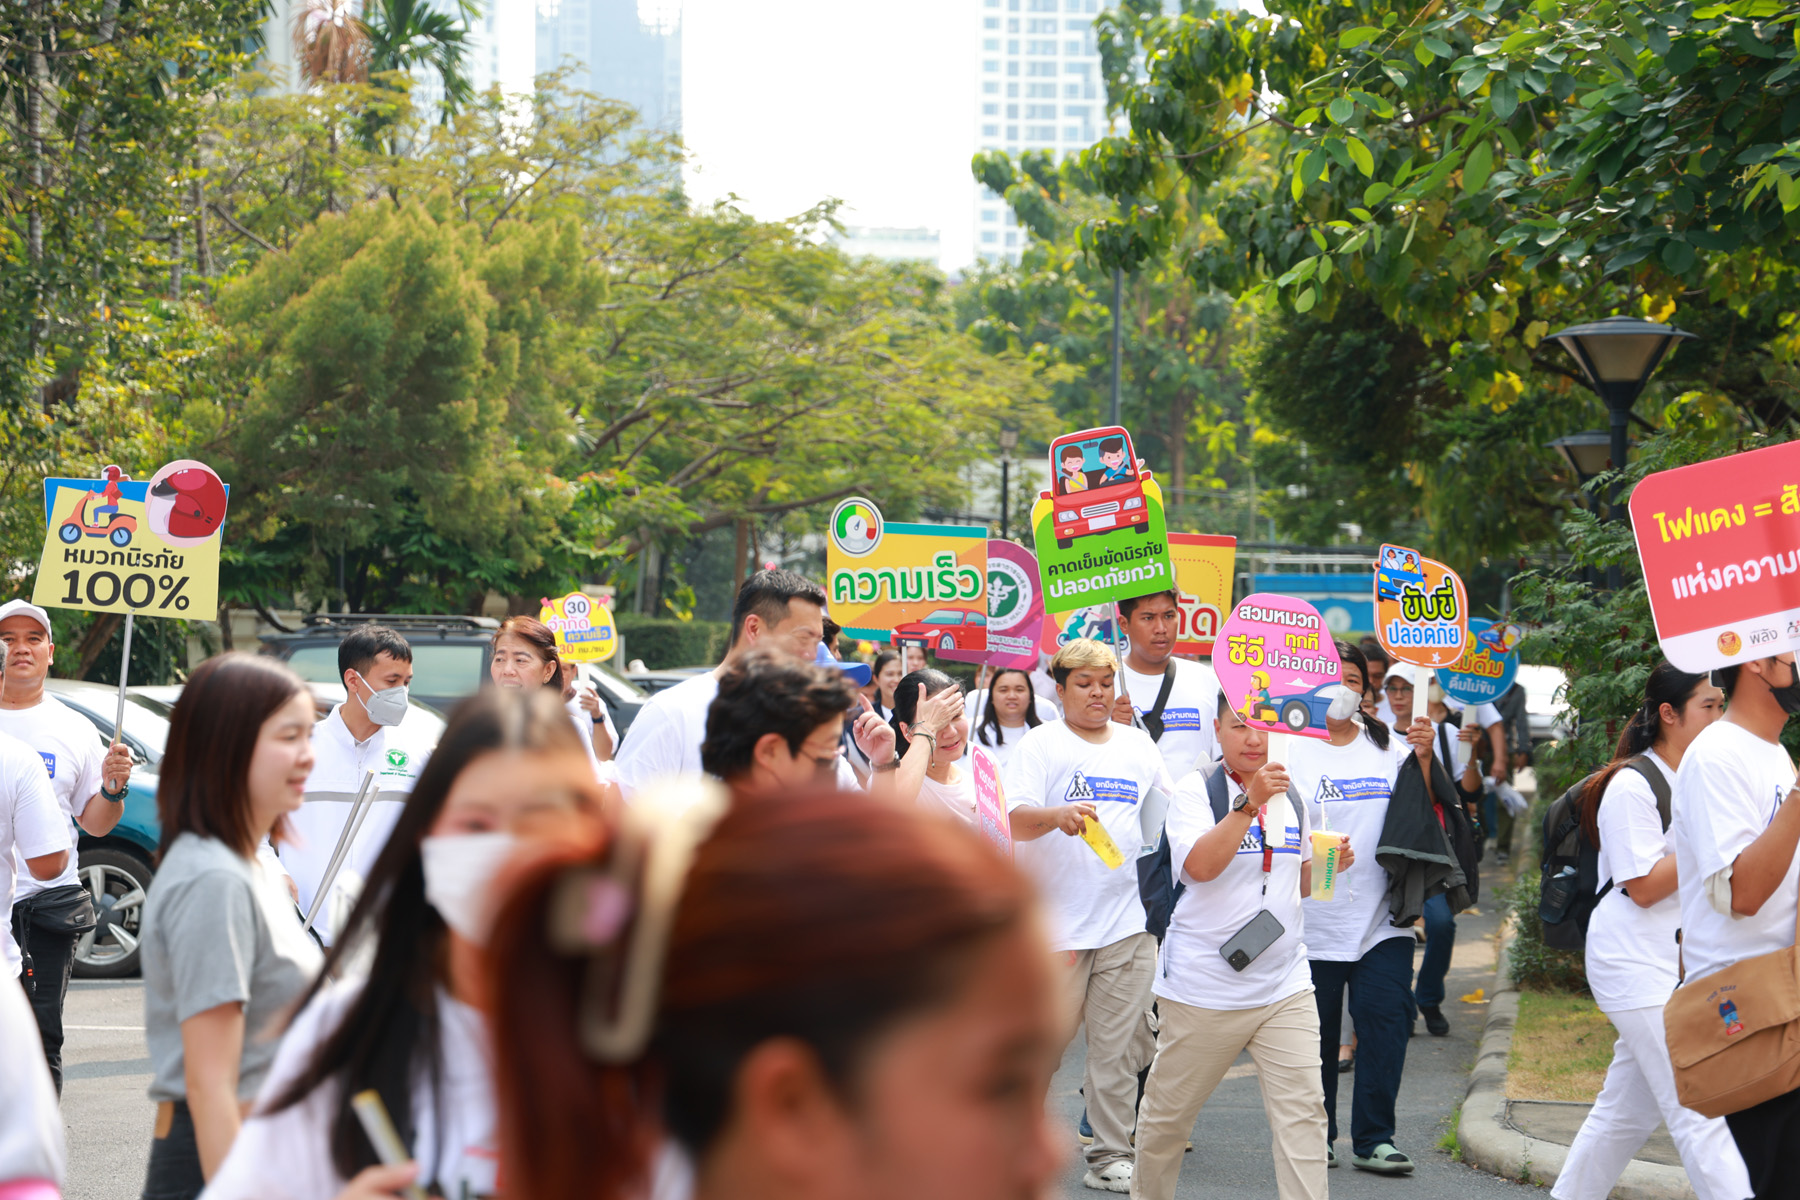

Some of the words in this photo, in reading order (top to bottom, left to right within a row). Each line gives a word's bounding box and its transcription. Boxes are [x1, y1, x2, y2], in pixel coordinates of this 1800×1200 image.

[1653, 503, 1746, 543] ไฟแดง
[64, 547, 184, 569] หมวกนิรภัย
[1048, 541, 1163, 576] คาดเข็มขัดนิรภัย
[833, 555, 981, 601] ความเร็ว
[1049, 558, 1165, 598] ปลอดภัยกว่า
[1671, 548, 1800, 600] แห่งความ
[61, 569, 190, 611] 100%
[1402, 576, 1457, 622] ขับขี่
[567, 601, 586, 614] 30
[1239, 605, 1319, 630] สวมหมวก
[548, 615, 589, 631] จำกัด
[567, 629, 609, 641] ความเร็ว
[1387, 621, 1460, 645] ปลอดภัย
[559, 643, 574, 655] 30
[1227, 634, 1265, 667] ชีวี
[1285, 632, 1319, 654] ทุกที
[1267, 650, 1338, 676] ปลอดภัย
[1448, 674, 1496, 695] ดื่มไม่ขับ
[1323, 847, 1337, 891] WEDRINK
